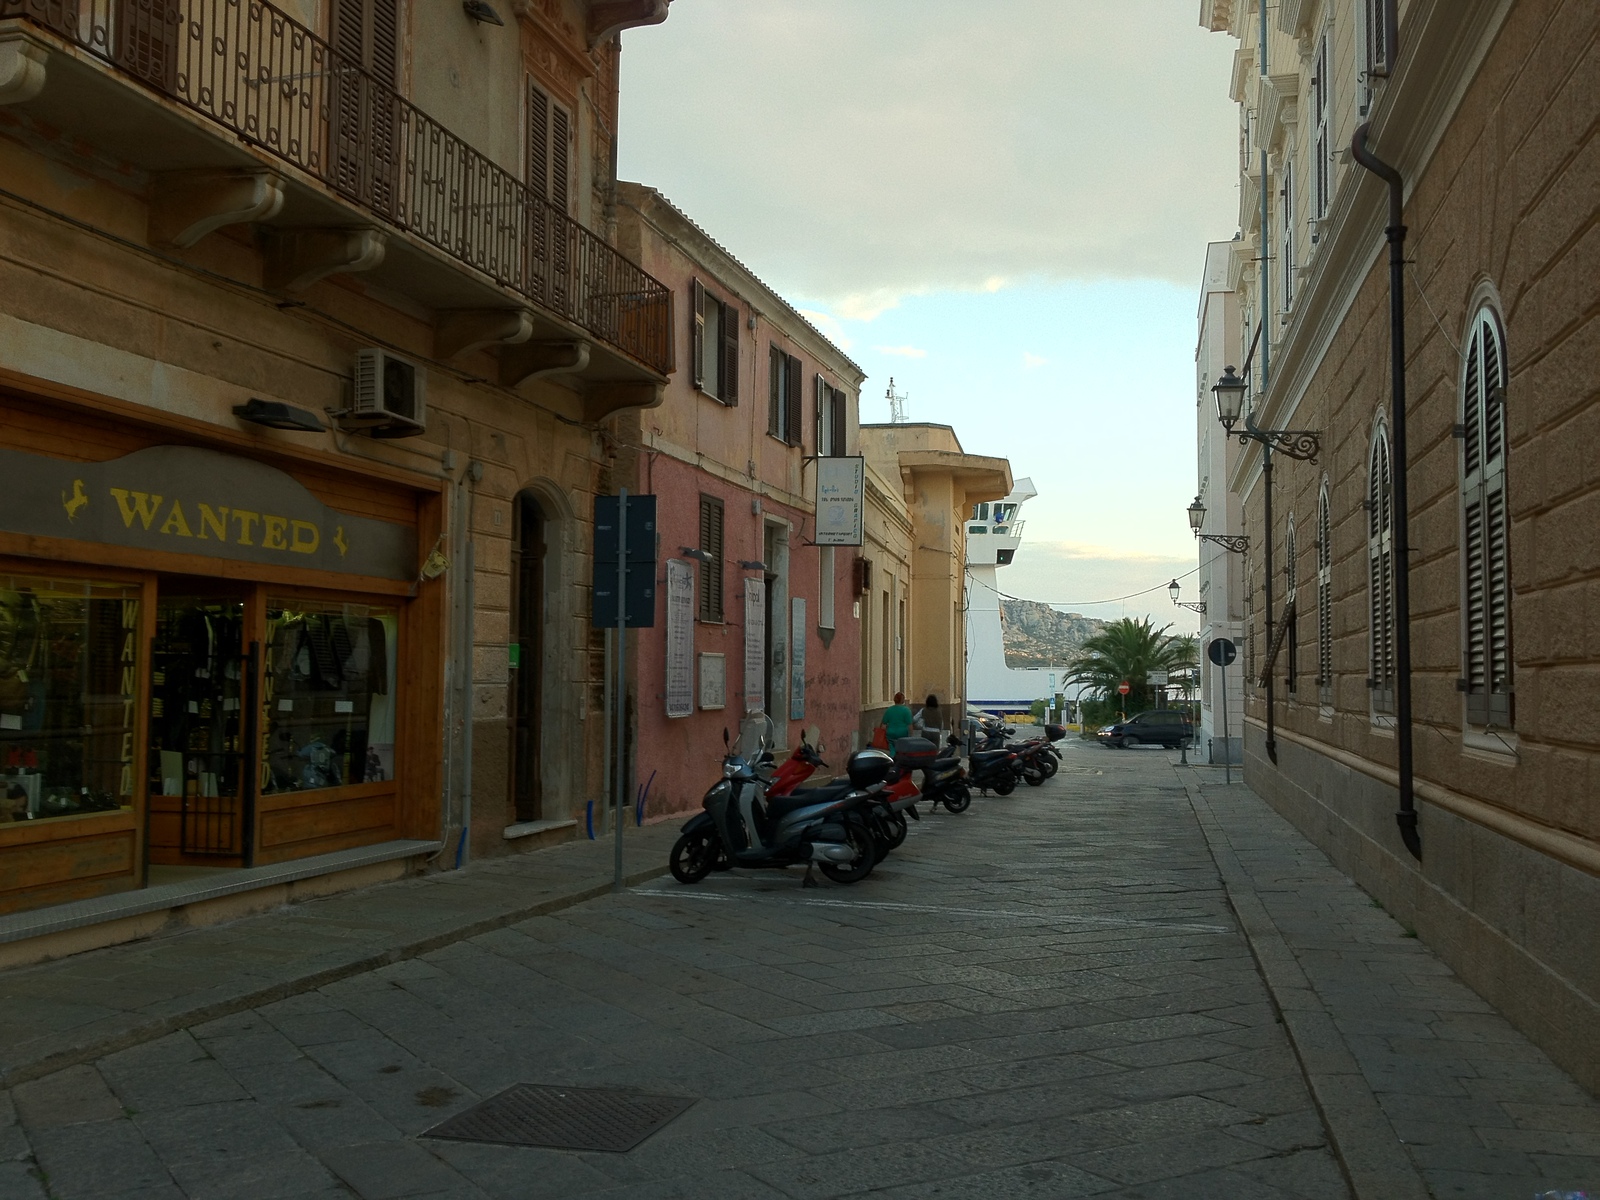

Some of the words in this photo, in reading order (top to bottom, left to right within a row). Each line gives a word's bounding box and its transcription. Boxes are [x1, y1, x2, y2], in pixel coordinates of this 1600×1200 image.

[109, 487, 320, 554] WANTED
[119, 599, 139, 796] WANTED
[260, 619, 276, 790] WANTED
